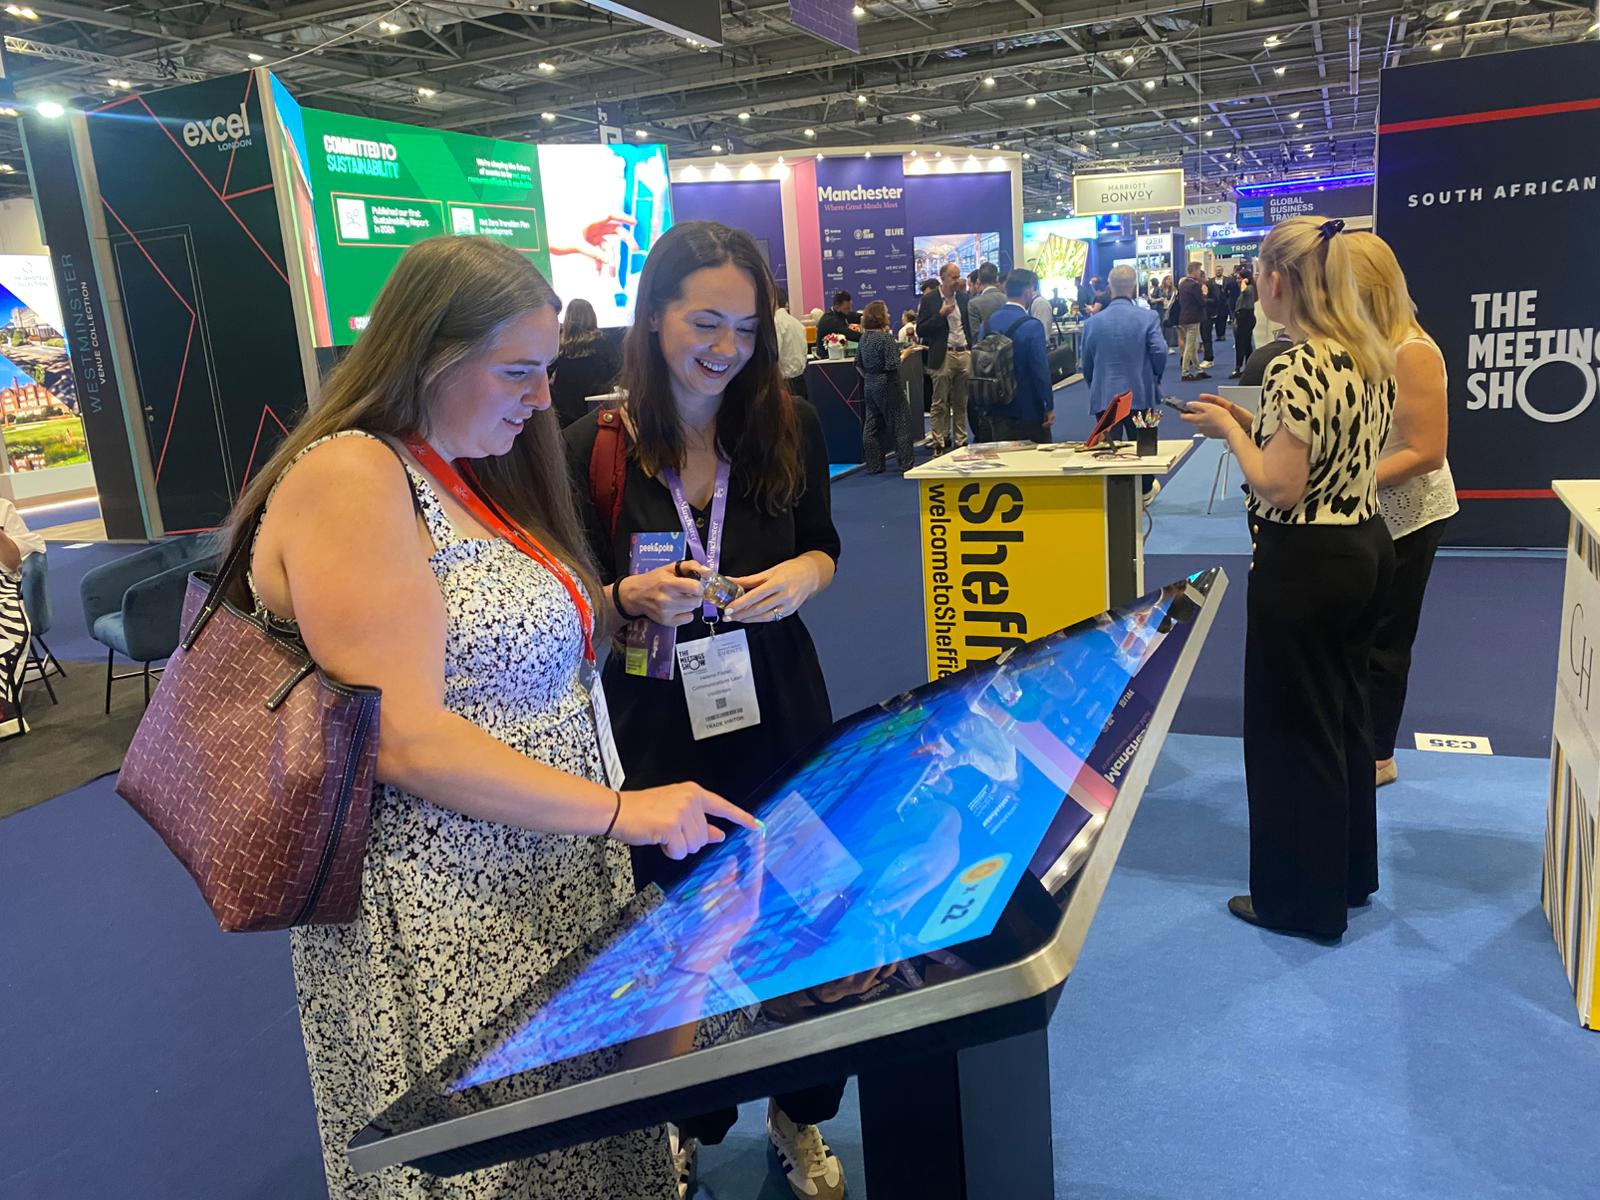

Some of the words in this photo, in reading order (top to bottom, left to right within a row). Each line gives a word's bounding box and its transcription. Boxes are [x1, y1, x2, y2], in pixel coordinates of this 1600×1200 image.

[183, 102, 250, 147] excel
[217, 139, 252, 151] LONDON
[323, 134, 380, 159] COMMITTED
[379, 142, 397, 161] TO
[326, 154, 399, 179] SUSTAINABILITY
[817, 184, 903, 202] Manchester
[1101, 190, 1153, 203] BONVOY
[1408, 187, 1482, 207] SOUTH
[1493, 175, 1597, 199] AFRICAN
[824, 203, 845, 212] Where
[845, 203, 863, 211] Great
[863, 202, 882, 210] Minds
[883, 201, 898, 209] Meet
[1270, 197, 1304, 206] GLOBAL
[371, 206, 398, 216] Published
[1187, 206, 1222, 216] WINGS
[1270, 203, 1314, 214] BUSINESS
[409, 217, 430, 228] Report
[891, 227, 904, 236] LIVE
[1231, 244, 1257, 252] TROOP
[80, 281, 99, 348] COLLECTION
[1470, 289, 1538, 329] THE
[61, 253, 103, 415] WESTMINSTER
[92, 350, 107, 385] VENUE
[1466, 356, 1600, 423] SHO
[678, 649, 689, 657] THE
[679, 652, 705, 663] MEETINGS
[681, 659, 706, 671] SHOW
[1429, 739, 1477, 749] C35
